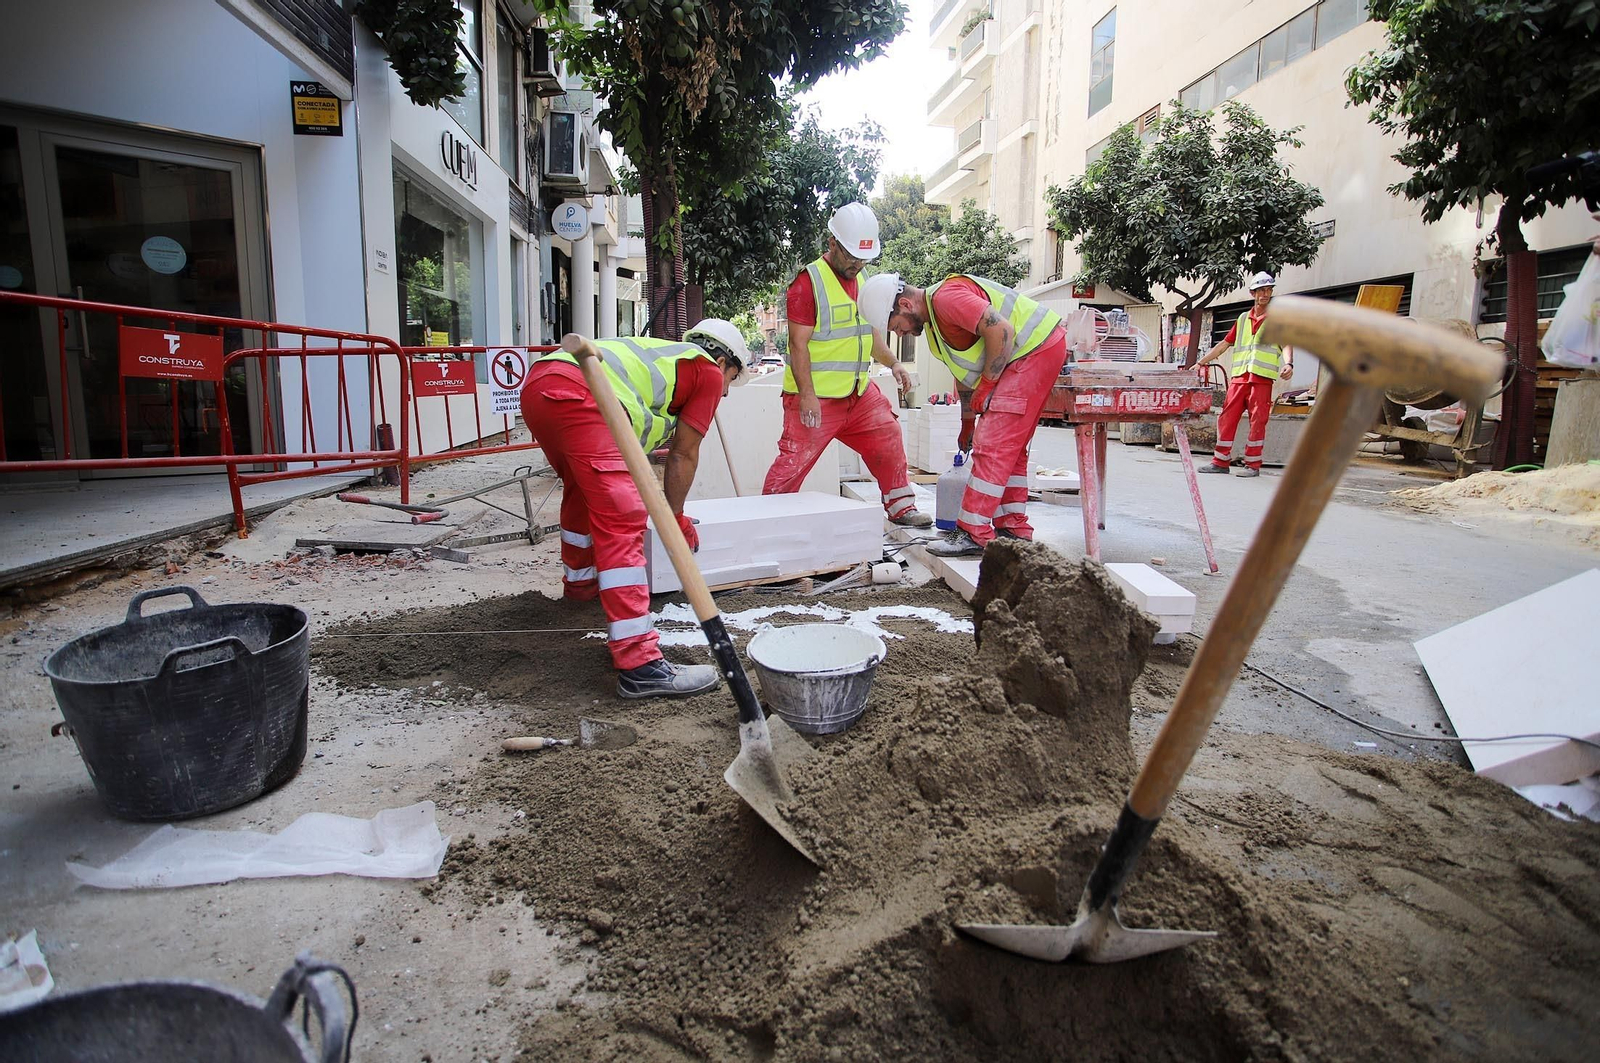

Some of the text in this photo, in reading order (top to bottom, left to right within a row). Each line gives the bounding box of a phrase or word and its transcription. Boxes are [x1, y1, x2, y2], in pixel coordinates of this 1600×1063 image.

[441, 130, 477, 189] CUEM
[138, 356, 204, 367] CONSTRUYA
[1120, 391, 1180, 410] MAUSA
